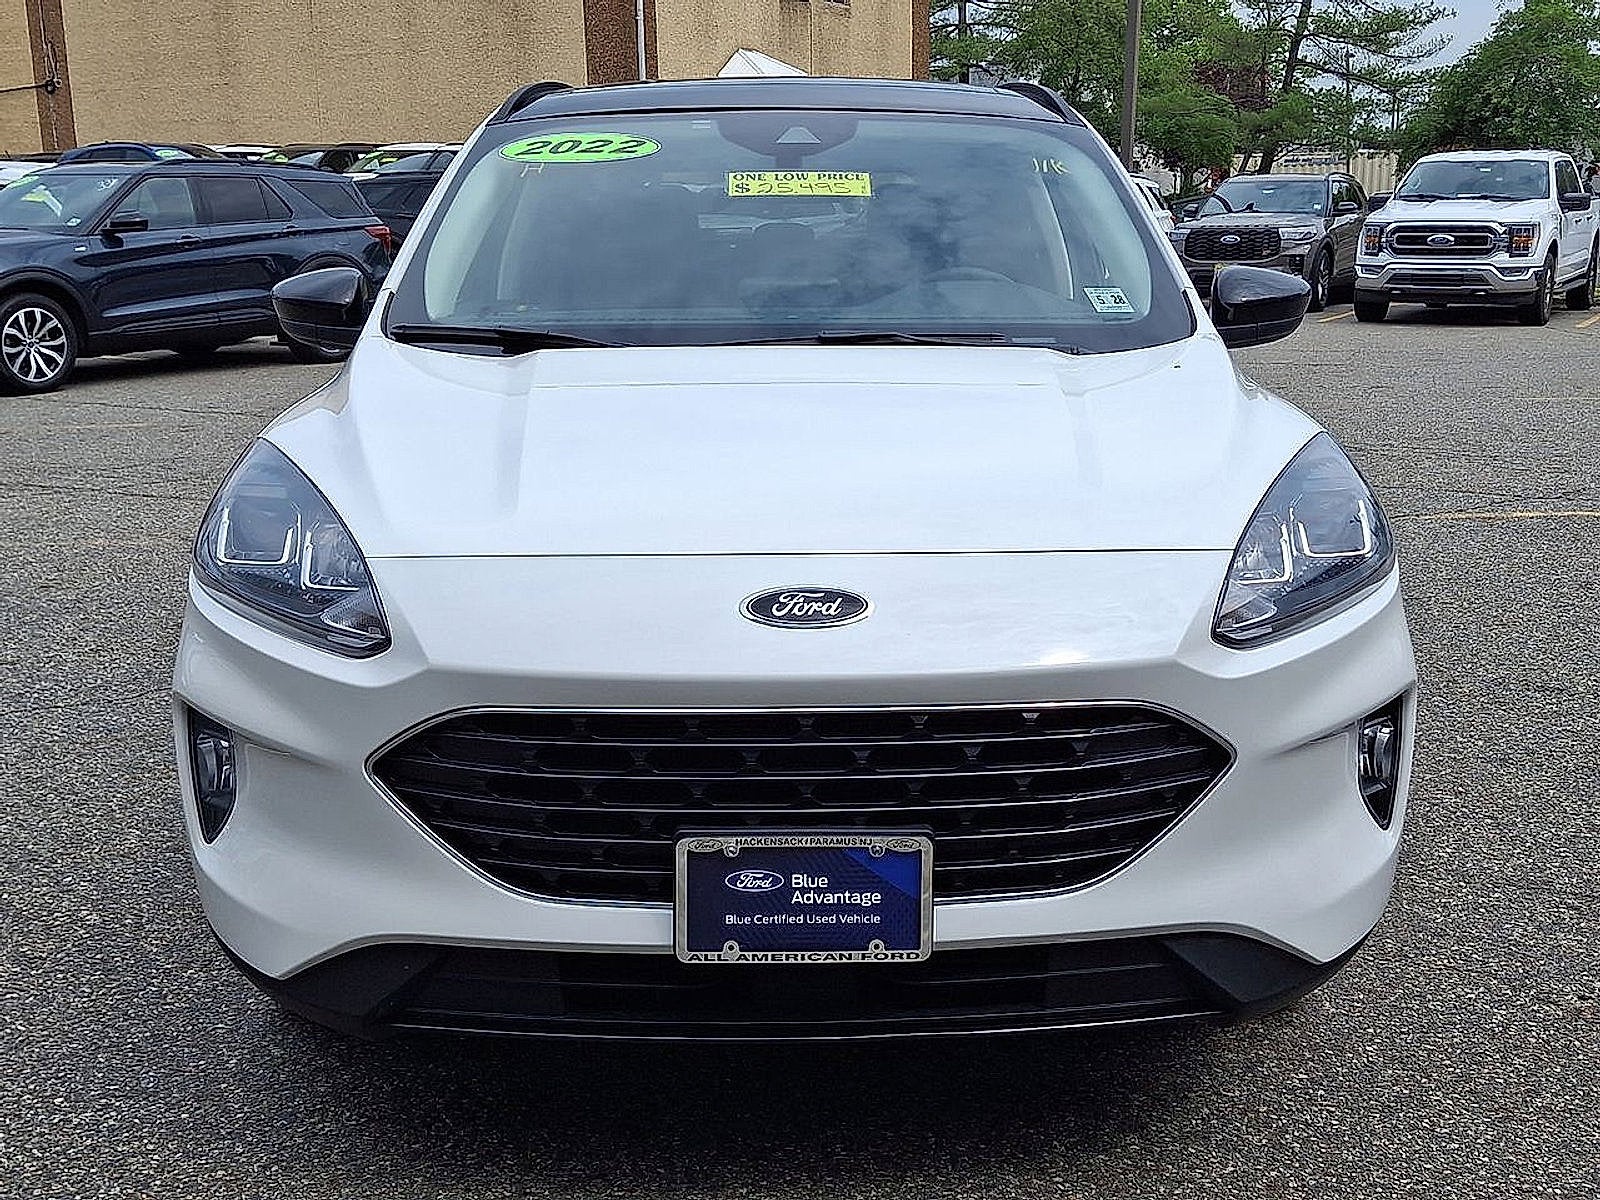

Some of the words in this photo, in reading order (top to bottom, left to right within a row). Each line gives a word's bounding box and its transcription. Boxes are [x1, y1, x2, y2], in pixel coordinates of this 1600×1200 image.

[514, 139, 648, 156] 2022
[733, 172, 767, 182] ONE
[774, 172, 809, 182] LOW
[817, 172, 865, 182] PRICE
[1110, 294, 1127, 305] 28
[771, 592, 843, 617] Ford
[736, 873, 773, 889] Ford
[791, 873, 829, 889] Blue
[791, 890, 882, 907] Advantage
[725, 914, 752, 925] Blue
[754, 914, 803, 925] Certified
[807, 914, 836, 925] Used
[839, 914, 881, 925] Vehicle
[687, 952, 729, 962] ALL
[736, 952, 852, 962] AMERICAN
[861, 951, 920, 961] FORD
